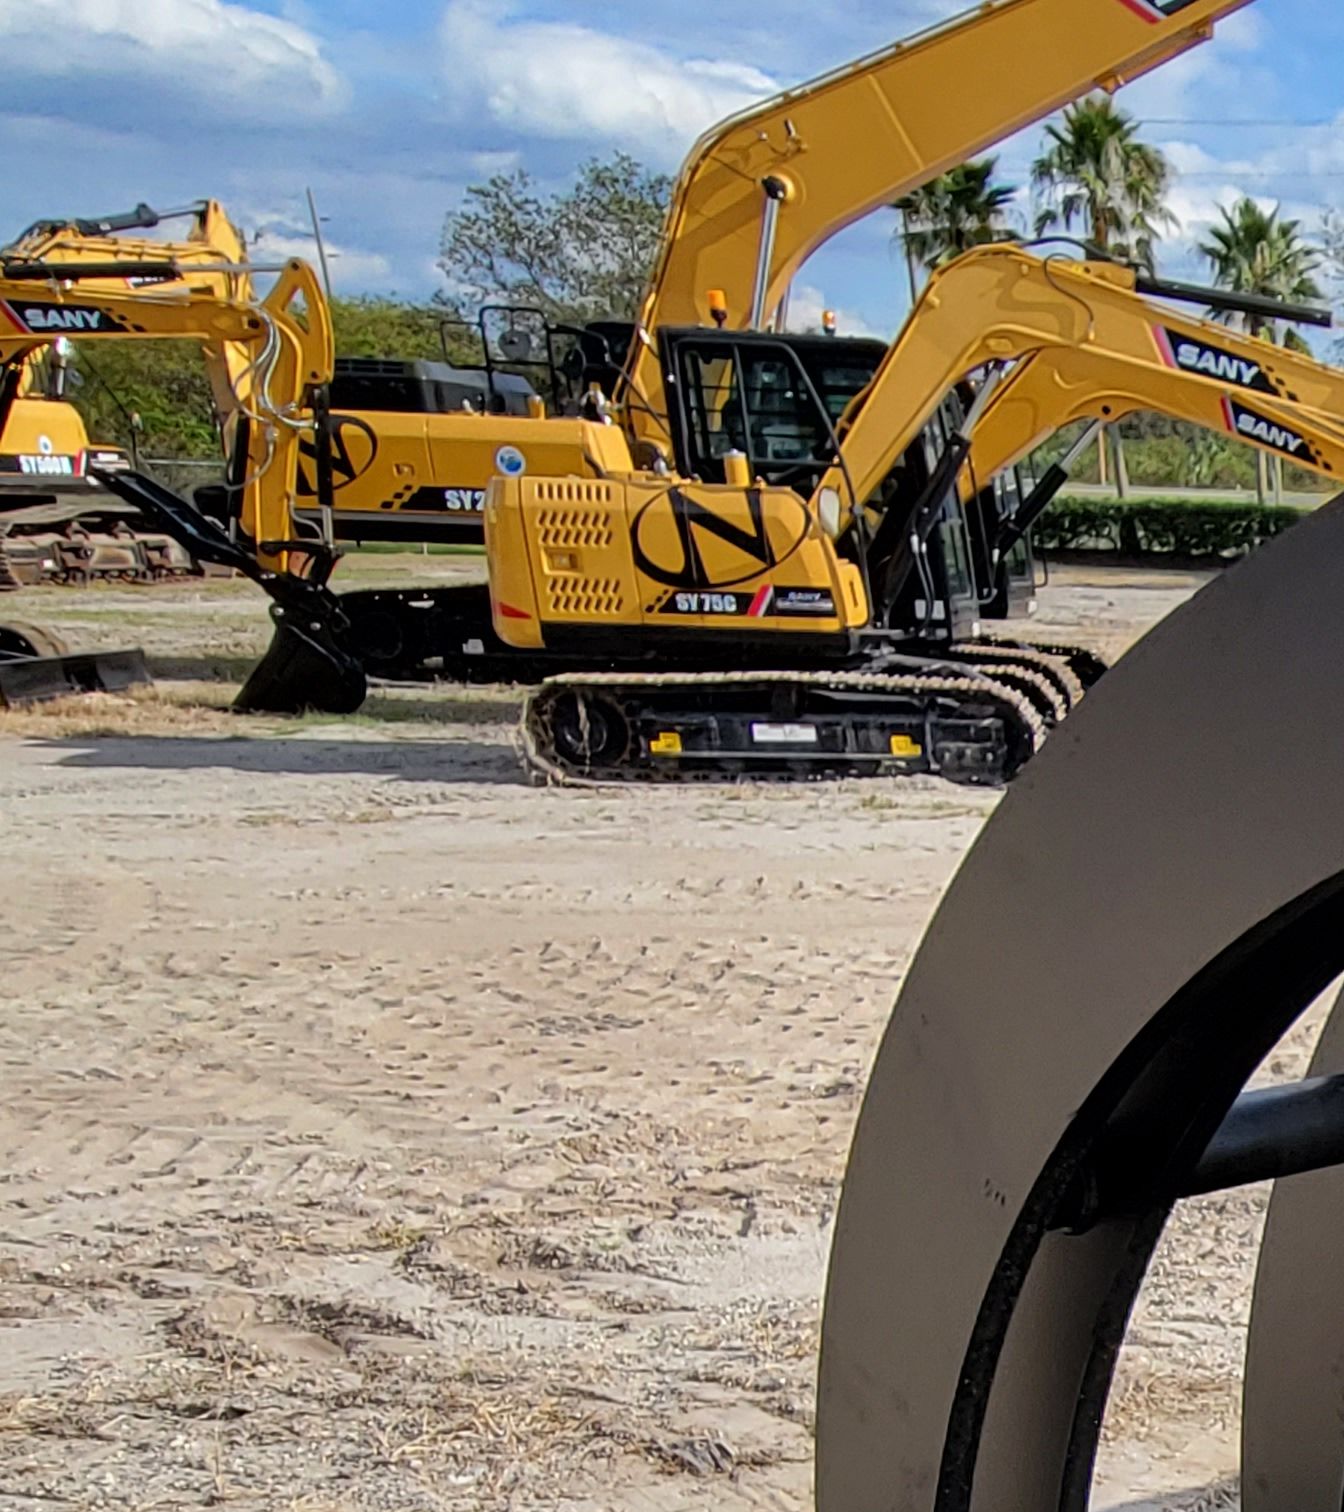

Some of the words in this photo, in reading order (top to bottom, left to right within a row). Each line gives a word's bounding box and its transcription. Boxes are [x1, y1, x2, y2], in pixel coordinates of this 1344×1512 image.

[24, 308, 101, 329] SANY
[1177, 343, 1260, 385] SANY
[1237, 413, 1304, 452] SANY
